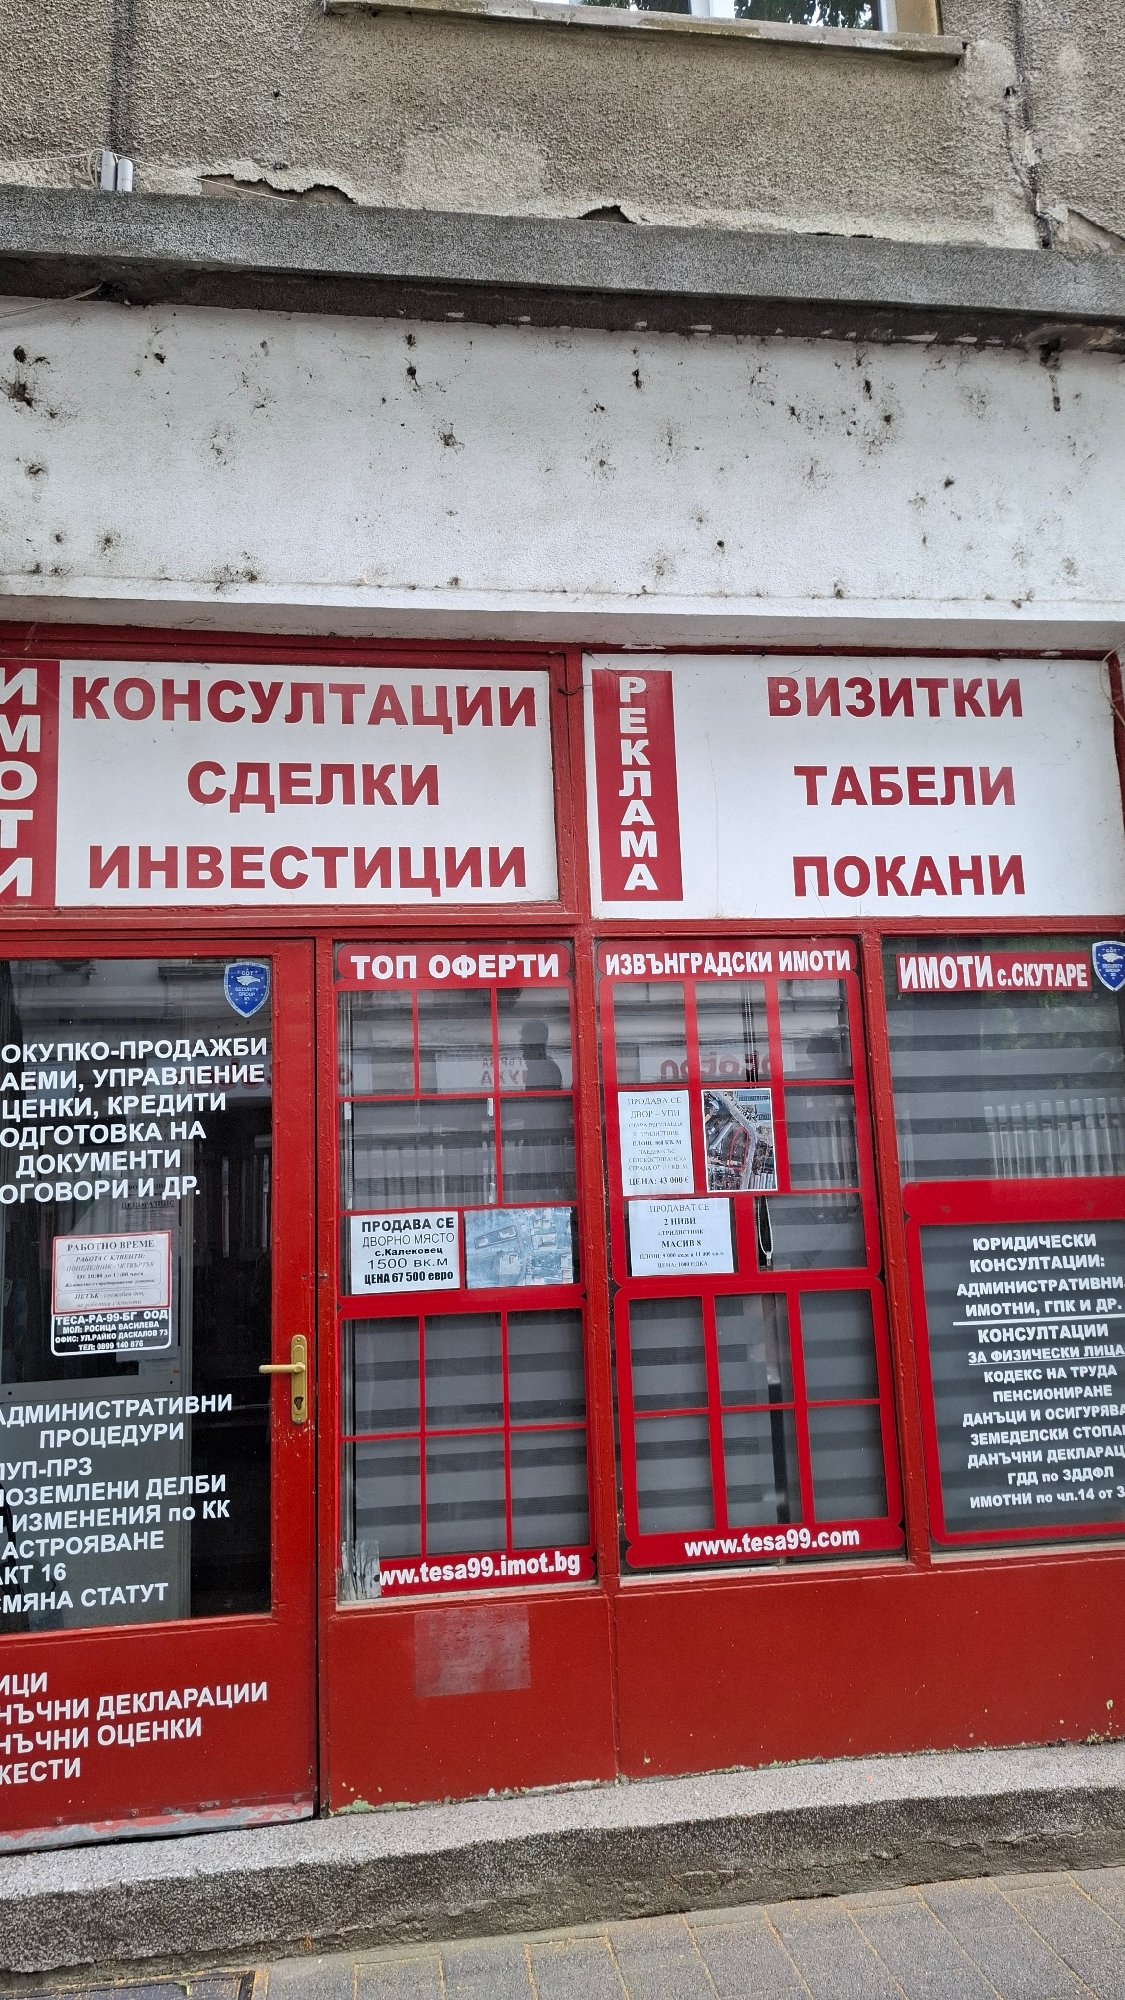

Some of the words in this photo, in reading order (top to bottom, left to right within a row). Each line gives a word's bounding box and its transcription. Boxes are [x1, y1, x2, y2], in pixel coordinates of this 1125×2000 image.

[72, 676, 536, 734] КОНСУЛТАЦИИ
[768, 676, 1023, 717] ВИЗИТКИ
[187, 761, 440, 813] СДЕЛКИ
[619, 676, 659, 891] РЕКЛАМА
[794, 766, 1015, 806] ТАБЕЛИ
[89, 845, 526, 897] ИНВЕСТИЦИИ
[792, 854, 1026, 897] ПОКАНИ
[350, 955, 416, 980] ТОП
[428, 954, 559, 978] ОФЕРТИ
[605, 952, 772, 976] ИЗВЪНГРАДСКИ
[778, 950, 850, 972] ИМОТИ
[900, 955, 994, 989] ИМОТИ
[997, 963, 1088, 987] с.СКУТАРЕ
[1, 1037, 267, 1063] ОКУПКО-ПРОДАЖБИ
[0, 1070, 84, 1092] АЕМИ,
[93, 1064, 265, 1088] УПРАВЛЕНИЕ
[2, 1097, 99, 1122] ЦЕНКИ,
[108, 1092, 226, 1116] КРЕДИТИ
[628, 1097, 668, 1105] ПРОДАВА
[670, 1096, 681, 1104] СЕ
[0, 1122, 163, 1150] ОДГОТОВКА
[170, 1120, 207, 1140] НА
[16, 1149, 181, 1178] ДОКУМЕНТИ
[0, 1178, 129, 1205] ОГОВОРИ
[138, 1177, 155, 1198] И
[162, 1176, 200, 1200] ДР.
[630, 1178, 657, 1186] ЦЕНА:
[650, 1204, 696, 1213] ПРОДАВАТ
[362, 1218, 431, 1233] ПРОДАВА
[436, 1217, 454, 1229] СЕ
[68, 1242, 117, 1251] РАБОТНО
[120, 1240, 155, 1249] ВРЕМЕ
[362, 1235, 411, 1248] ДВОРНО
[414, 1232, 455, 1245] МЯСТО
[662, 1240, 695, 1248] МАСИВ
[972, 1234, 1097, 1252] ЮРИДИЧЕСКИ
[375, 1248, 443, 1257] с.Калековец
[970, 1254, 1105, 1273] КОНСУЛТАЦИИ:
[368, 1258, 408, 1270] 1500
[414, 1258, 448, 1268] вк.м
[364, 1273, 390, 1285] ЦЕНА
[392, 1272, 403, 1283] 67
[406, 1271, 425, 1282] 500
[428, 1272, 453, 1281] евро
[56, 1312, 137, 1326] ТЕСА-РА-99-БГ
[144, 1310, 168, 1320] ООД
[966, 1302, 1040, 1317] ИМОТНИ,
[1044, 1300, 1076, 1313] ГПК
[1080, 1300, 1091, 1311] И
[1096, 1298, 1122, 1313] ДР.
[55, 1336, 79, 1344] ОФИС:
[80, 1332, 116, 1342] УЛ.РАЙКО
[118, 1330, 157, 1341] ДАСКАЛОВ
[63, 1326, 82, 1334] МОЛ:
[84, 1325, 117, 1333] РОСИЦА
[118, 1321, 159, 1331] ВАСИЛЕВА
[978, 1324, 1109, 1343] КОНСУЛТАЦИИ
[97, 1342, 114, 1350] 0899
[968, 1351, 987, 1363] ЗА
[991, 1346, 1080, 1361] ФИЗИЧЕСКИ
[984, 1369, 1042, 1384] КОДЕКС
[1047, 1368, 1067, 1379] НА
[1070, 1364, 1117, 1378] ТРУДА
[992, 1384, 1113, 1403] ПЕНСИОНИРАНЕ
[962, 1410, 1027, 1427] ДАНЪЦИ
[1030, 1409, 1041, 1421] И
[40, 1412, 184, 1449] ПРОЦЕДУРИ
[970, 1428, 1069, 1446] ЗЕМЕДЕЛСКИ
[968, 1450, 1043, 1469] ДАНЪЧНИ
[1046, 1444, 1125, 1463] ДЕКЛАРАЦ
[0, 1457, 93, 1480] УП-ПРЗ
[1008, 1472, 1039, 1486] ГДД
[1042, 1473, 1059, 1483] по
[1063, 1466, 1115, 1482] ЗДДФЛ
[0, 1480, 139, 1507] ОЗЕМЛЕНИ
[146, 1474, 226, 1501] ДЕЛБИ
[970, 1492, 1033, 1509] ИМОТНИ
[1036, 1494, 1053, 1504] по
[1056, 1488, 1095, 1502] чл.14
[1098, 1489, 1113, 1500] от
[12, 1504, 161, 1533] ИЗМЕНЕНИЯ
[168, 1506, 196, 1522] по
[202, 1500, 231, 1519] КК
[2, 1530, 164, 1560] АСТРОЯВАНЕ
[684, 1528, 860, 1558] www.tesa99.com
[0, 1565, 34, 1585] КТ
[42, 1563, 67, 1582] 16
[0, 1590, 73, 1613] МЯНА
[81, 1583, 168, 1607] СТАТУТ
[0, 1698, 89, 1725] НЪЧНИ
[96, 1682, 268, 1720] ДЕКЛАРАЦИИ
[98, 1717, 202, 1747] ОЦЕНКИ
